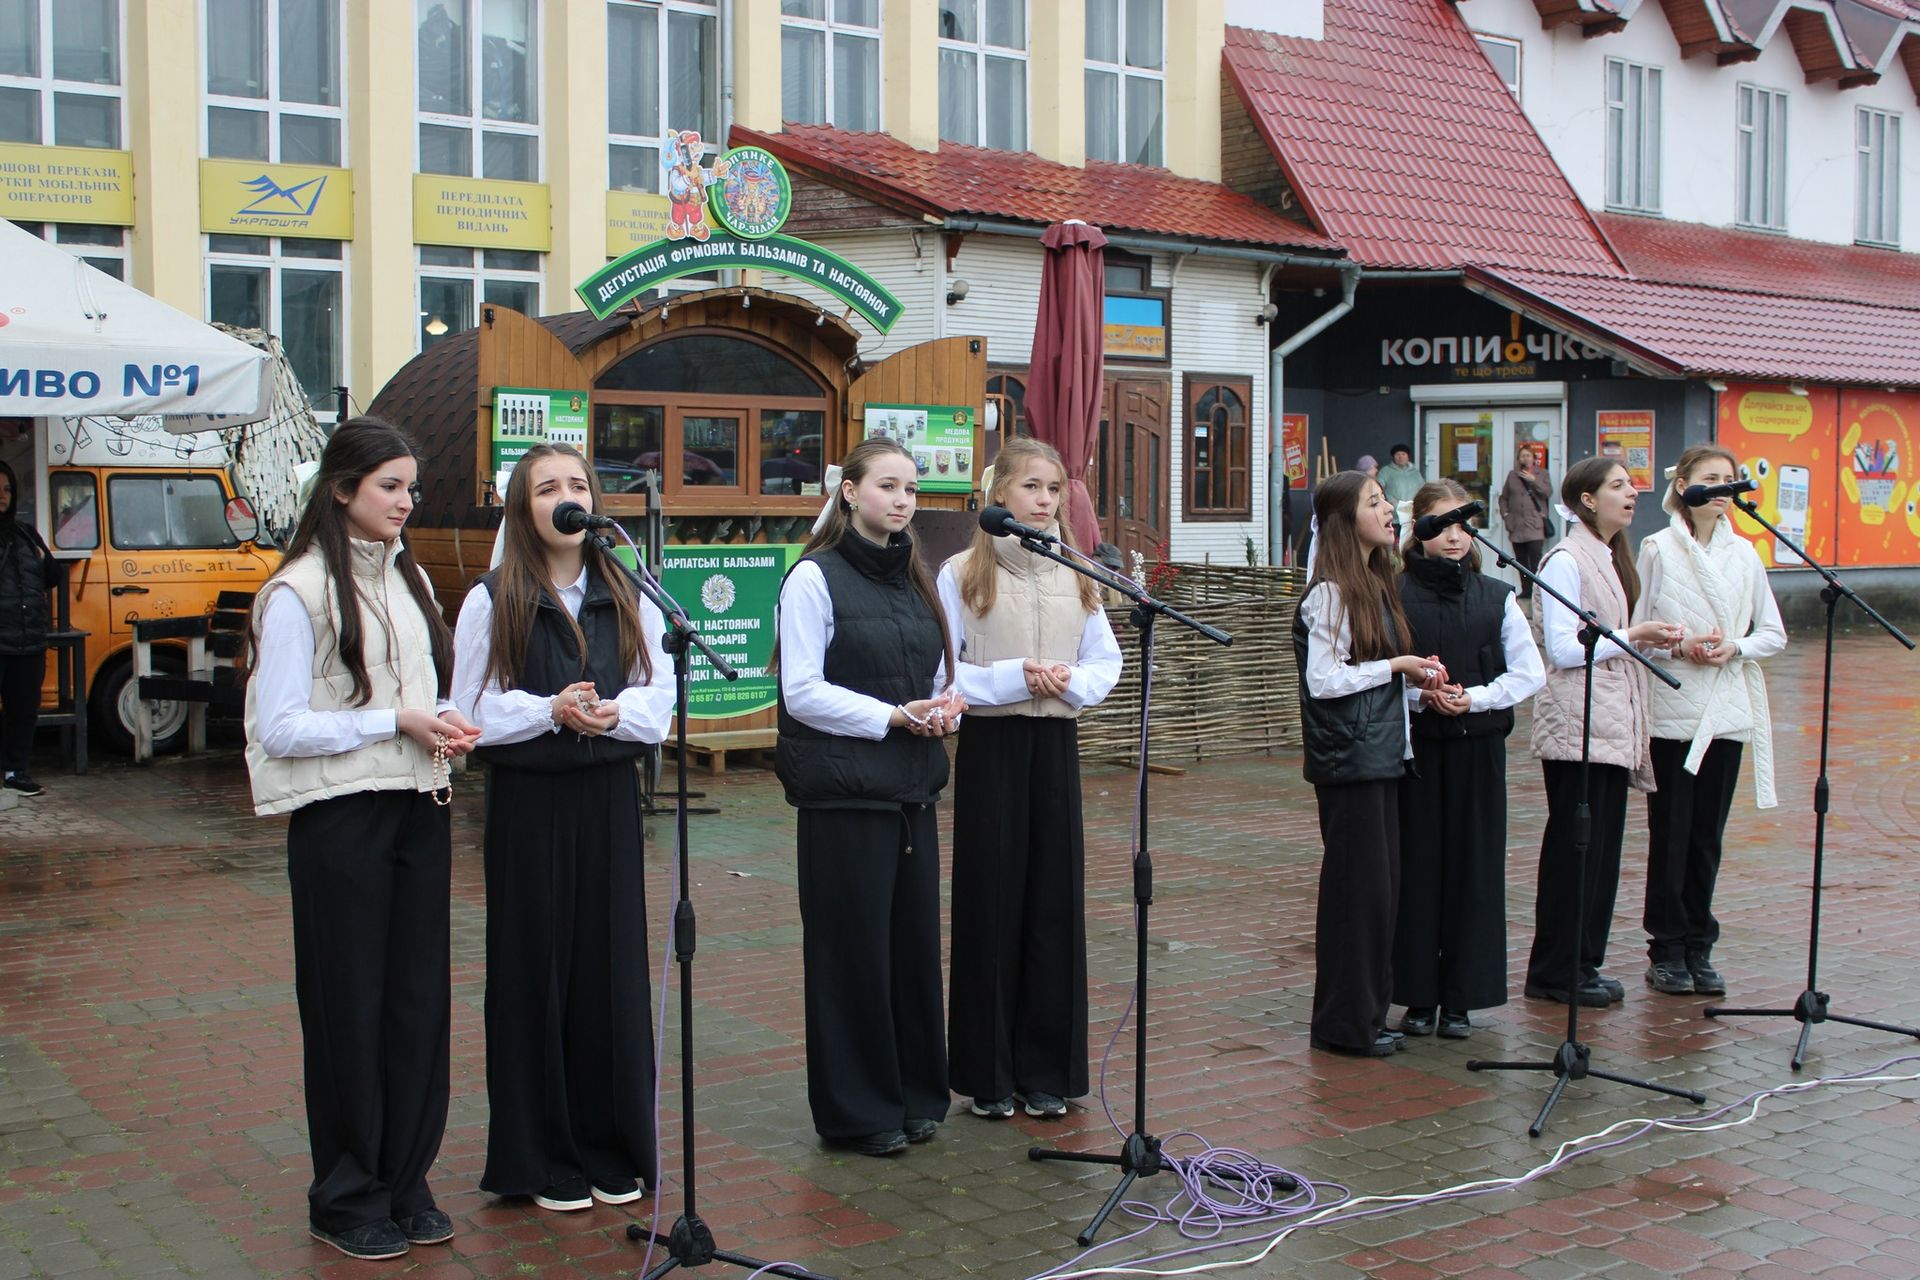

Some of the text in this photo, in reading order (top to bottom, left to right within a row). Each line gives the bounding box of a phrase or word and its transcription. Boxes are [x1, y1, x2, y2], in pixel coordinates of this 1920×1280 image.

[0, 163, 41, 174] ШОВІ
[39, 178, 121, 192] МОБІЛЬНИХ
[8, 191, 93, 204] ОПЕРАТОРІВ
[441, 190, 524, 206] ПЕРЕДПЛАТА
[436, 204, 528, 220] ПЕРІОДИЧНИХ
[632, 208, 671, 220] ВІДПРАВ
[229, 216, 309, 229] УКРПОШТА
[457, 220, 509, 233] ВИДАНЬ
[597, 242, 890, 318] ДЕГУСТАЦІЯ ФІРМОВИХ БАЛЬЗАМІВ ТА НАСТОЯНОК
[1455, 365, 1534, 379] те що треба
[0, 364, 200, 399] ИВО №1
[723, 556, 775, 568] БАЛЬЗАМИ
[704, 618, 760, 631] НАСТОЯНКИ
[690, 633, 747, 647] ОЛЬФАРІВ
